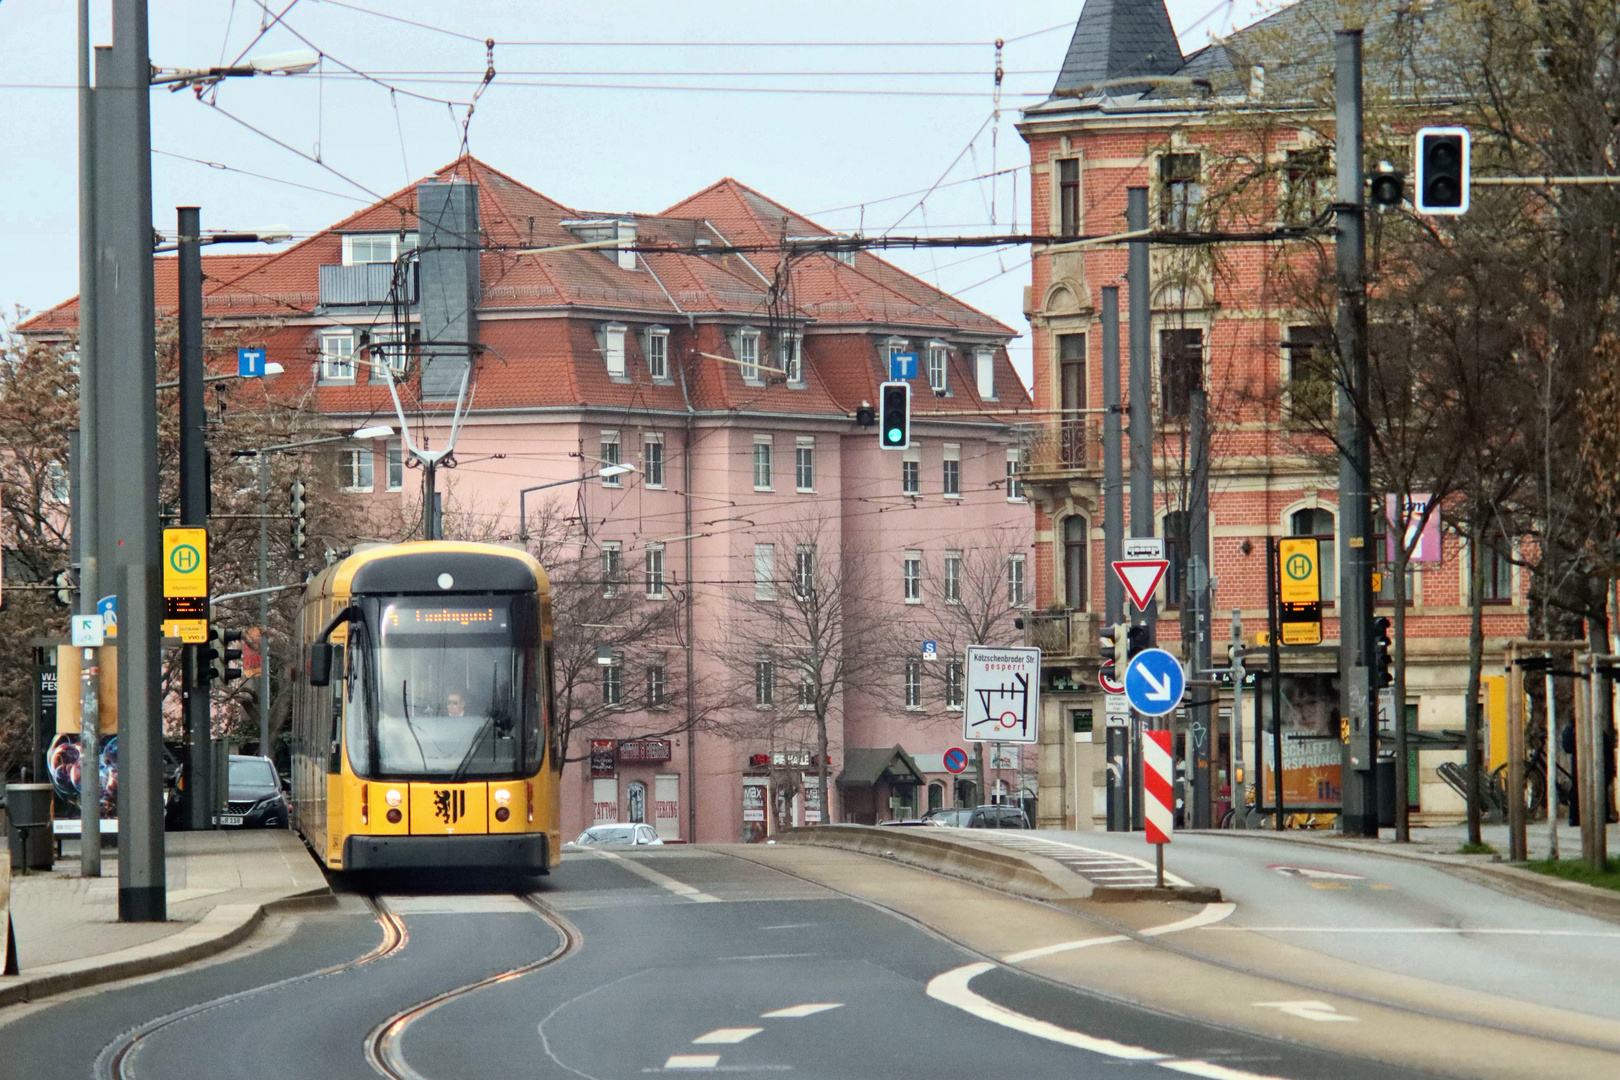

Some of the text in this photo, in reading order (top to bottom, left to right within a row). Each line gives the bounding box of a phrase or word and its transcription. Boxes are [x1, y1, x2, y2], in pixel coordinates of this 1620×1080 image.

[243, 352, 260, 373] T
[896, 356, 913, 376] T
[179, 550, 192, 568] H
[1293, 559, 1305, 575] H
[926, 643, 935, 653] S
[984, 663, 1025, 672] gesperrt
[1282, 741, 1331, 758] SCHAFFT
[1269, 753, 1342, 772] VRSPRUNG!
